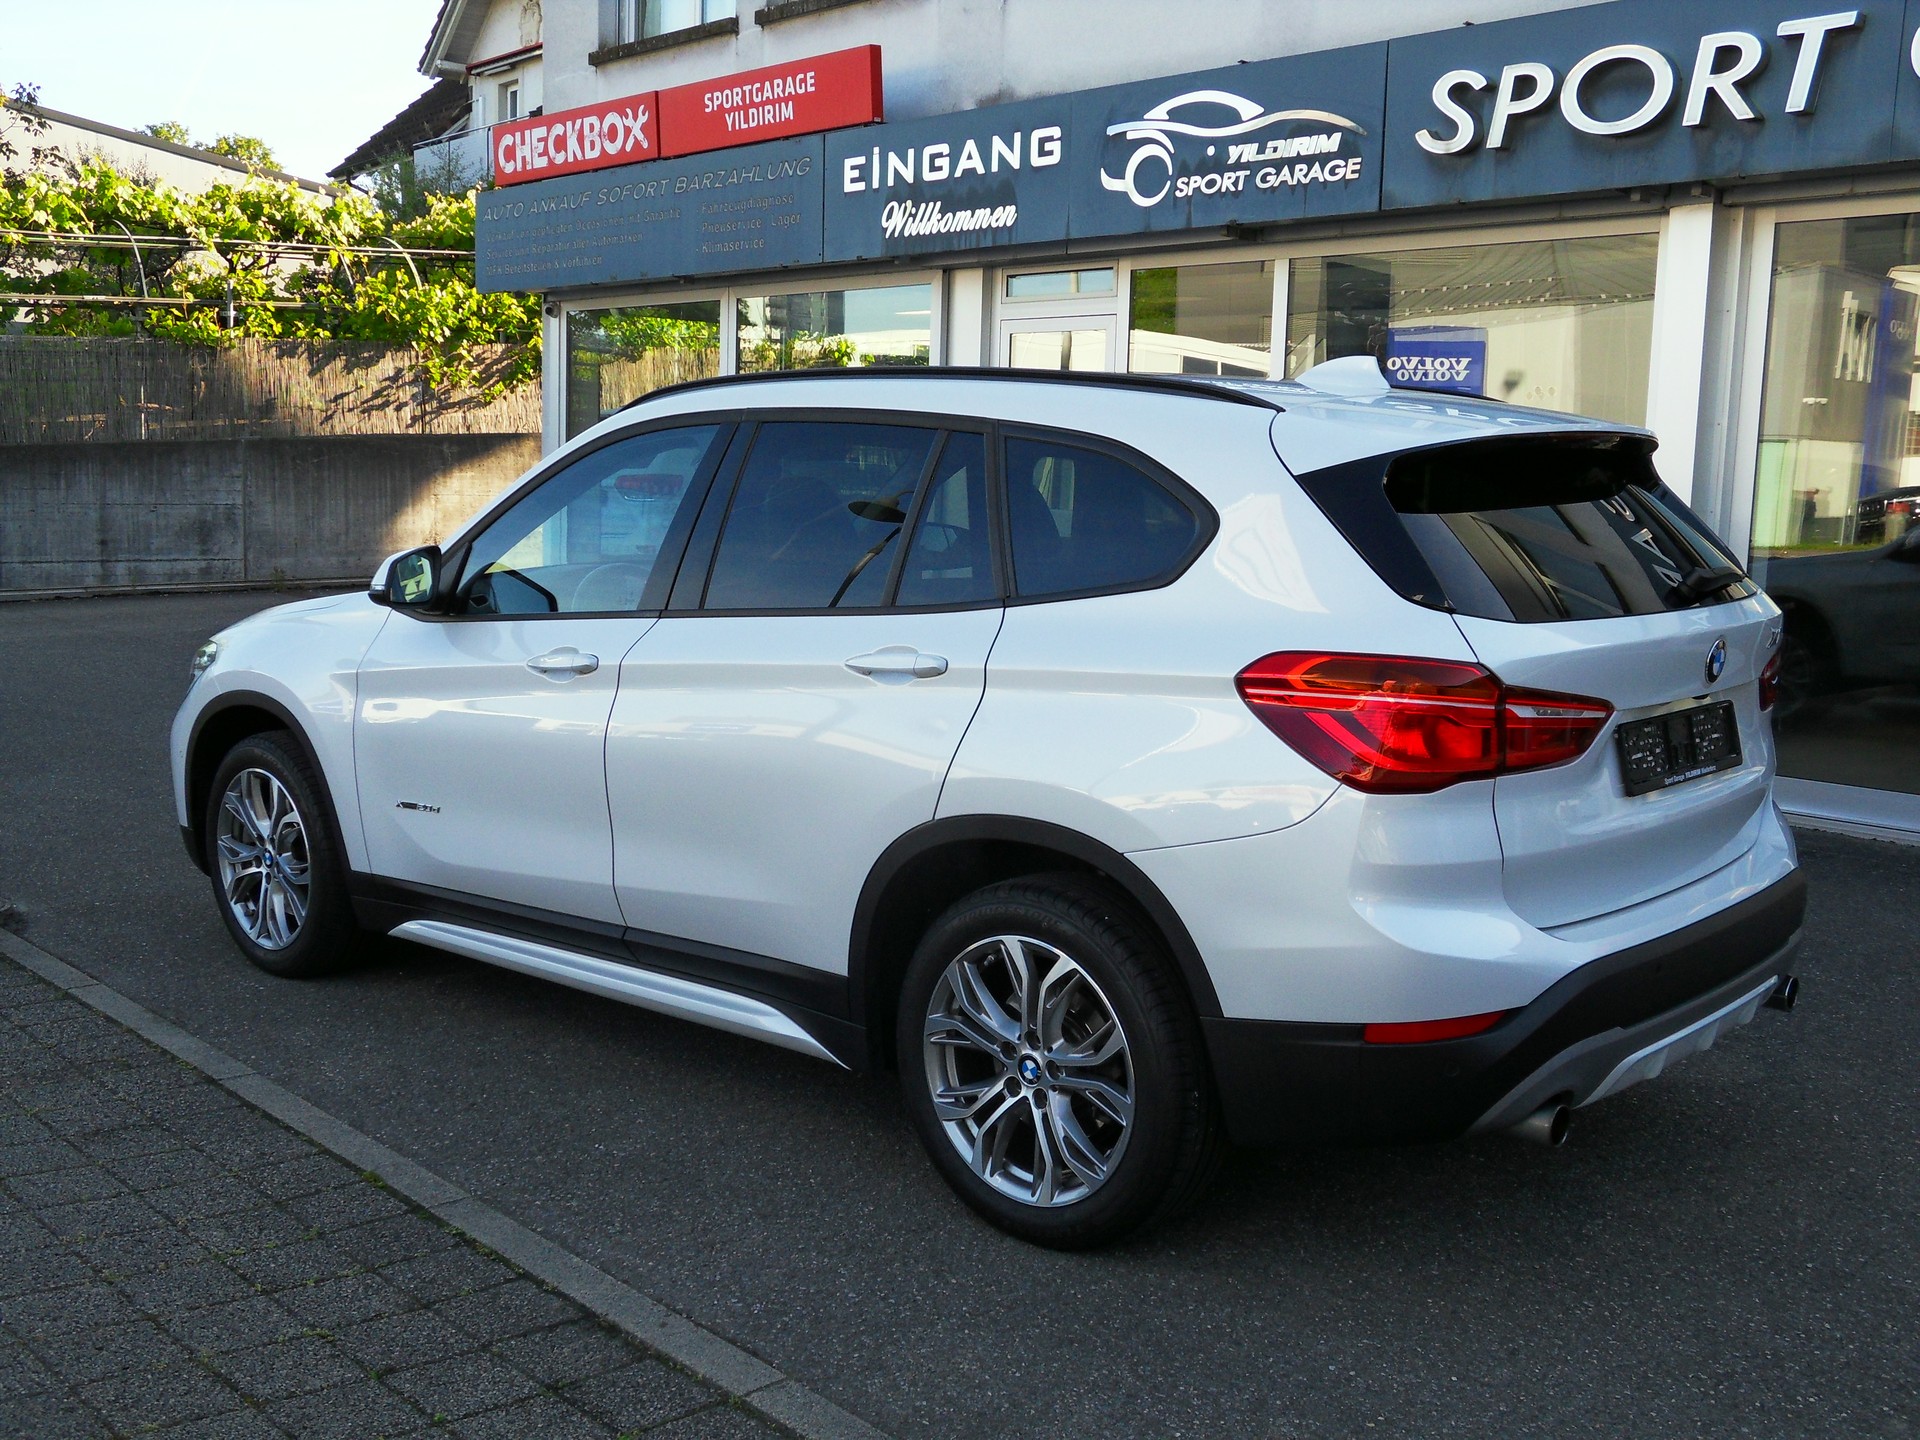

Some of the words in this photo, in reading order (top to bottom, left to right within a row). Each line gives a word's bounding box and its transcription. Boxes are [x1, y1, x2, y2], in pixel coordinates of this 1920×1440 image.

[703, 70, 816, 113] SPORTGARAGE
[1414, 10, 1865, 155] SPORT
[724, 100, 795, 132] YILDIRIM
[498, 104, 649, 174] CHECKBOX
[1227, 132, 1344, 164] YILDIRIM
[482, 202, 524, 221] AUTO
[528, 191, 592, 215] ANKAUF
[597, 177, 670, 205] SOFORT
[674, 155, 812, 194] BARZAHLUNG
[1174, 170, 1250, 198] SPORT
[1255, 157, 1363, 189] GARAGE
[771, 214, 801, 229] Lager
[880, 197, 1018, 240] Willkommen
[701, 238, 765, 253] Klimaservice
